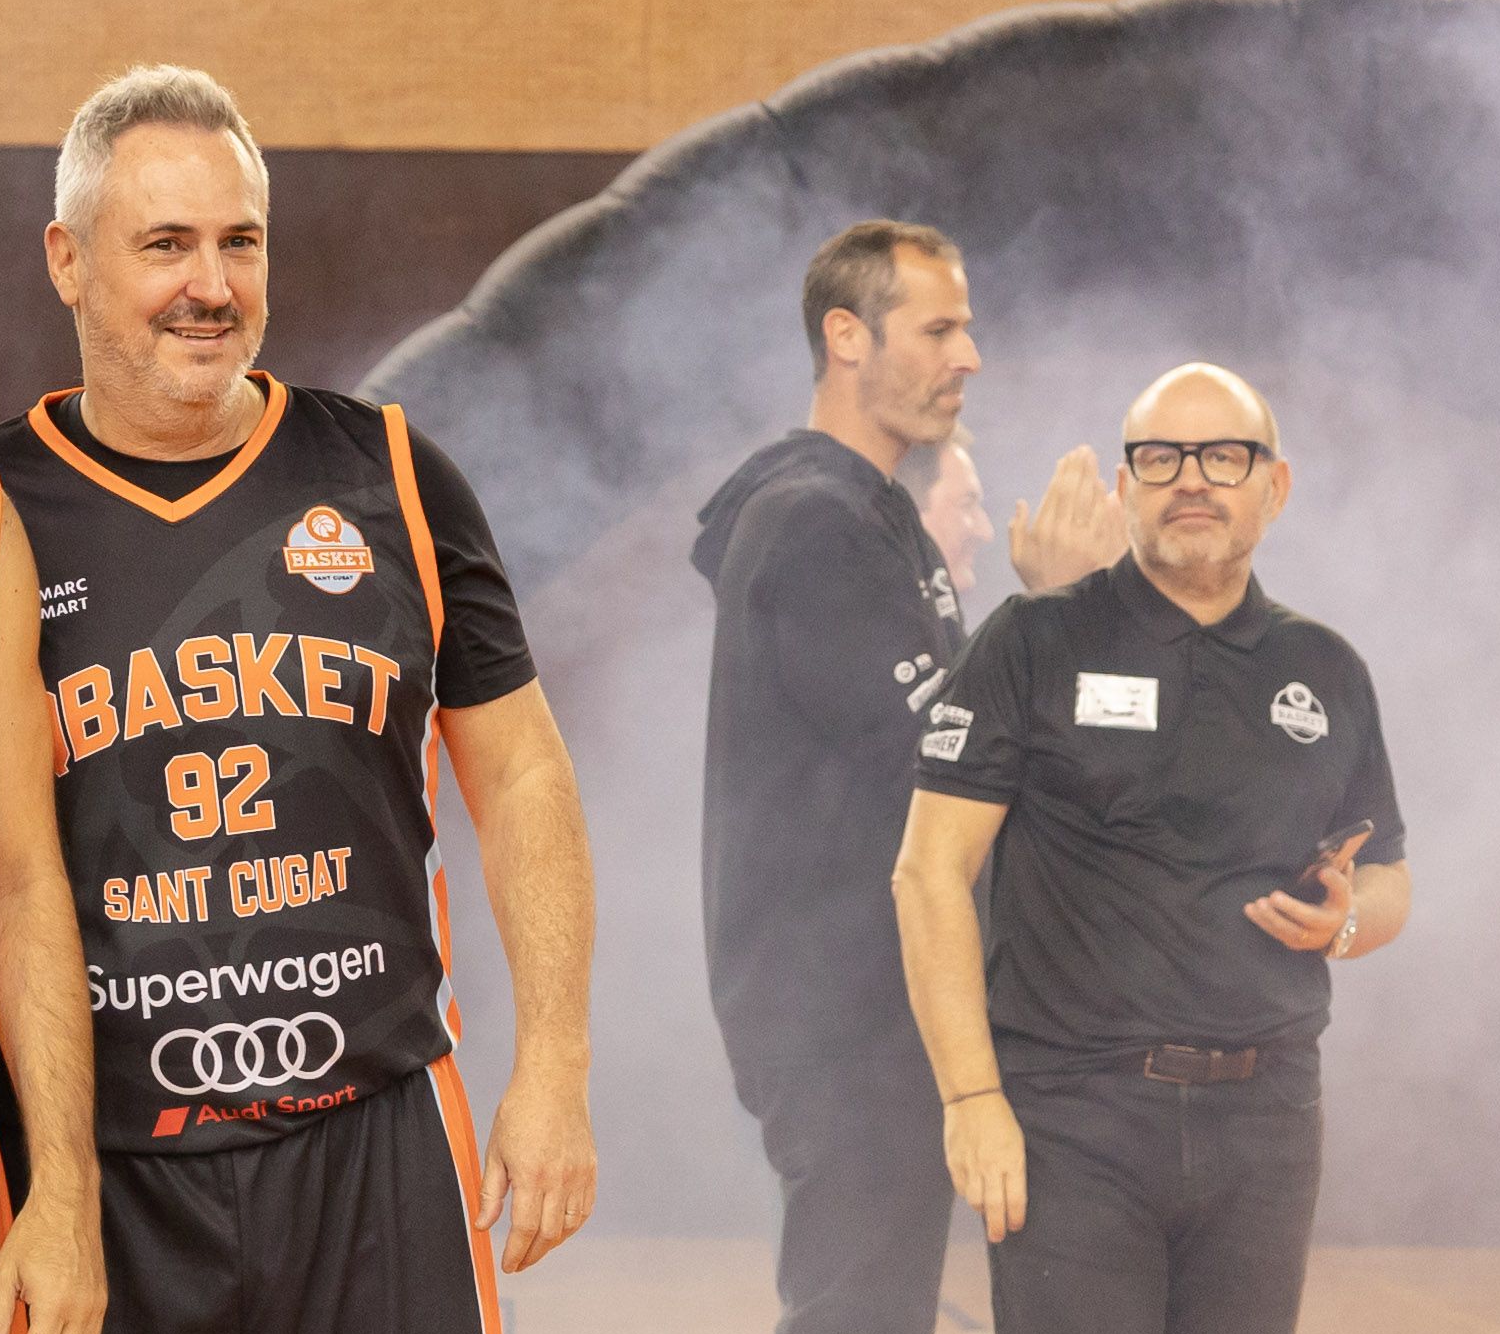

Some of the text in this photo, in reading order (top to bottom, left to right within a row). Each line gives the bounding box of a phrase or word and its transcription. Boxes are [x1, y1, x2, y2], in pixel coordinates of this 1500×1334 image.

[290, 551, 367, 567] BASKET
[40, 597, 89, 620] MART
[164, 743, 277, 842] 92
[103, 847, 353, 925] SANT CUGAT
[87, 941, 386, 1019] Superwagen
[196, 1099, 269, 1127] Audi
